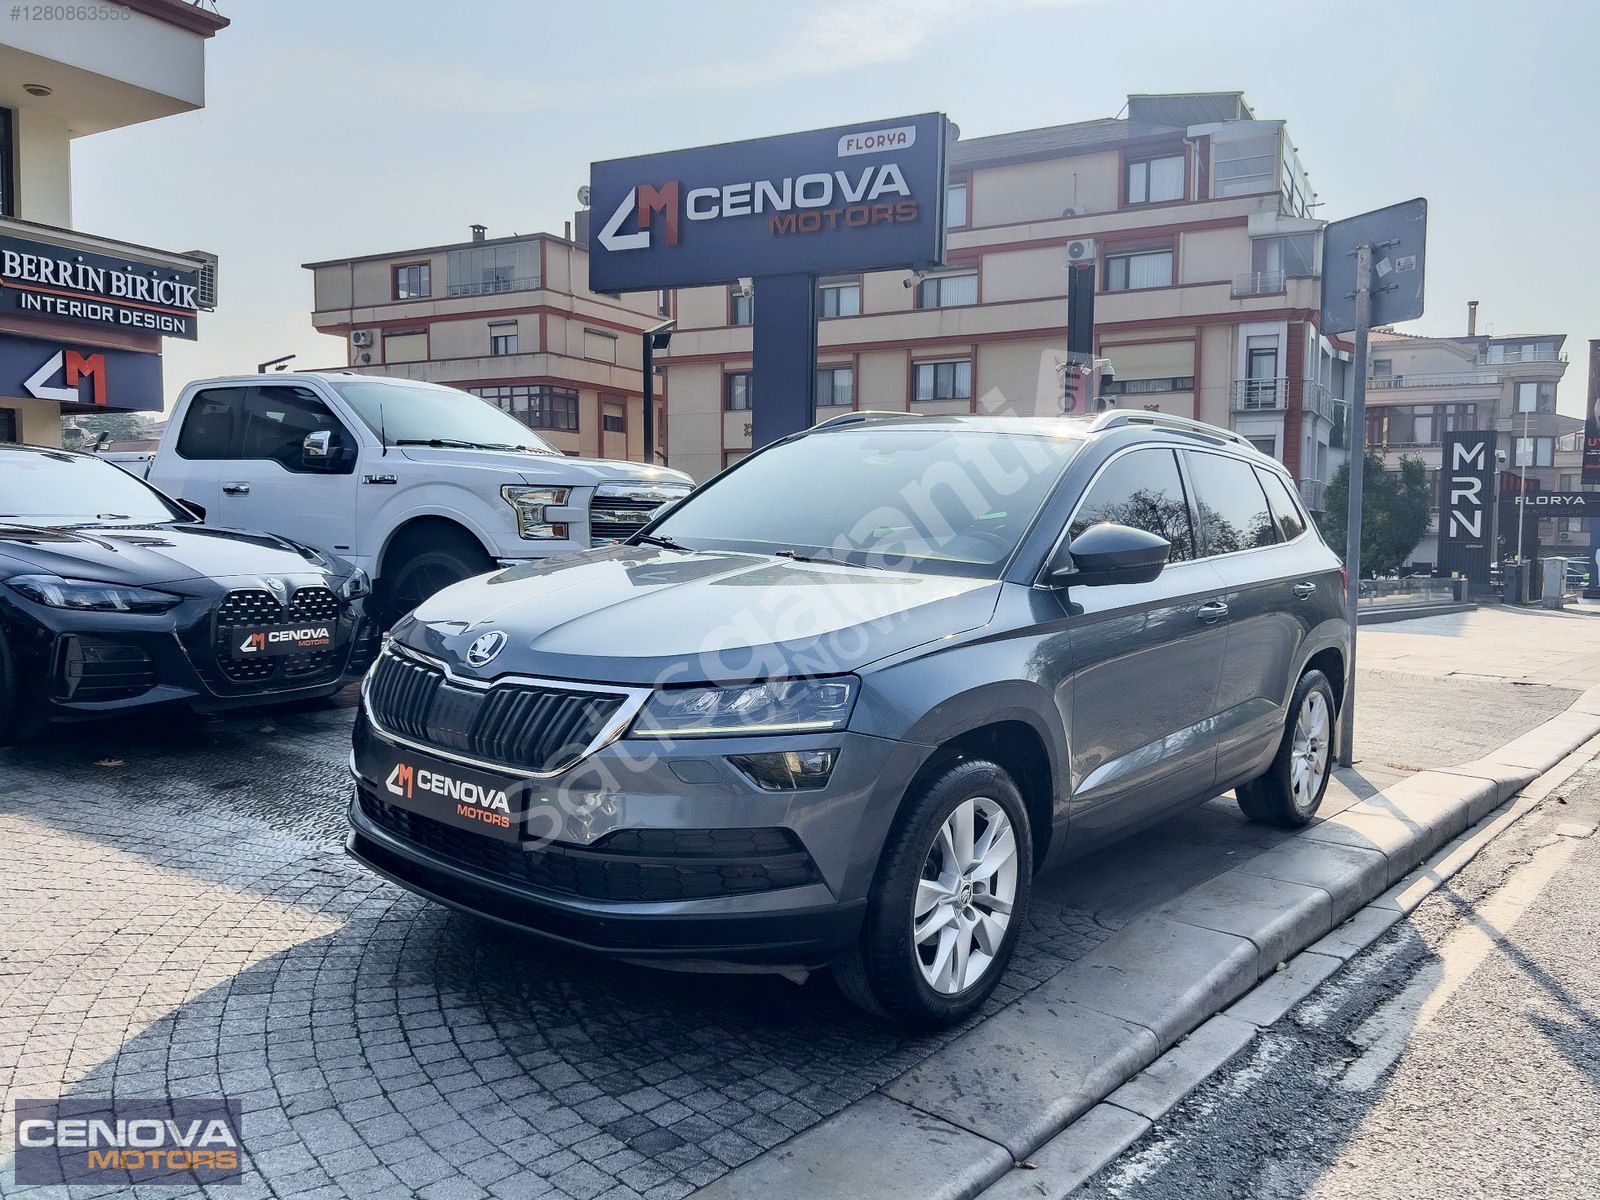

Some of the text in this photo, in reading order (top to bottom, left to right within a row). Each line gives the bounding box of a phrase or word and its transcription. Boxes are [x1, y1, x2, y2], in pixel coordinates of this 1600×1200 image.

[846, 131, 907, 152] FLORYA
[686, 163, 911, 221] CENOVA
[768, 199, 918, 236] MOTORS
[21, 293, 186, 333] INTERIOR DESIGN
[1449, 441, 1485, 538] MRN
[1514, 495, 1586, 505] FLORYA
[268, 628, 330, 643] CENOVA
[298, 638, 330, 647] MOTORS
[417, 769, 510, 813] CENOVA
[457, 804, 510, 828] MOTORS
